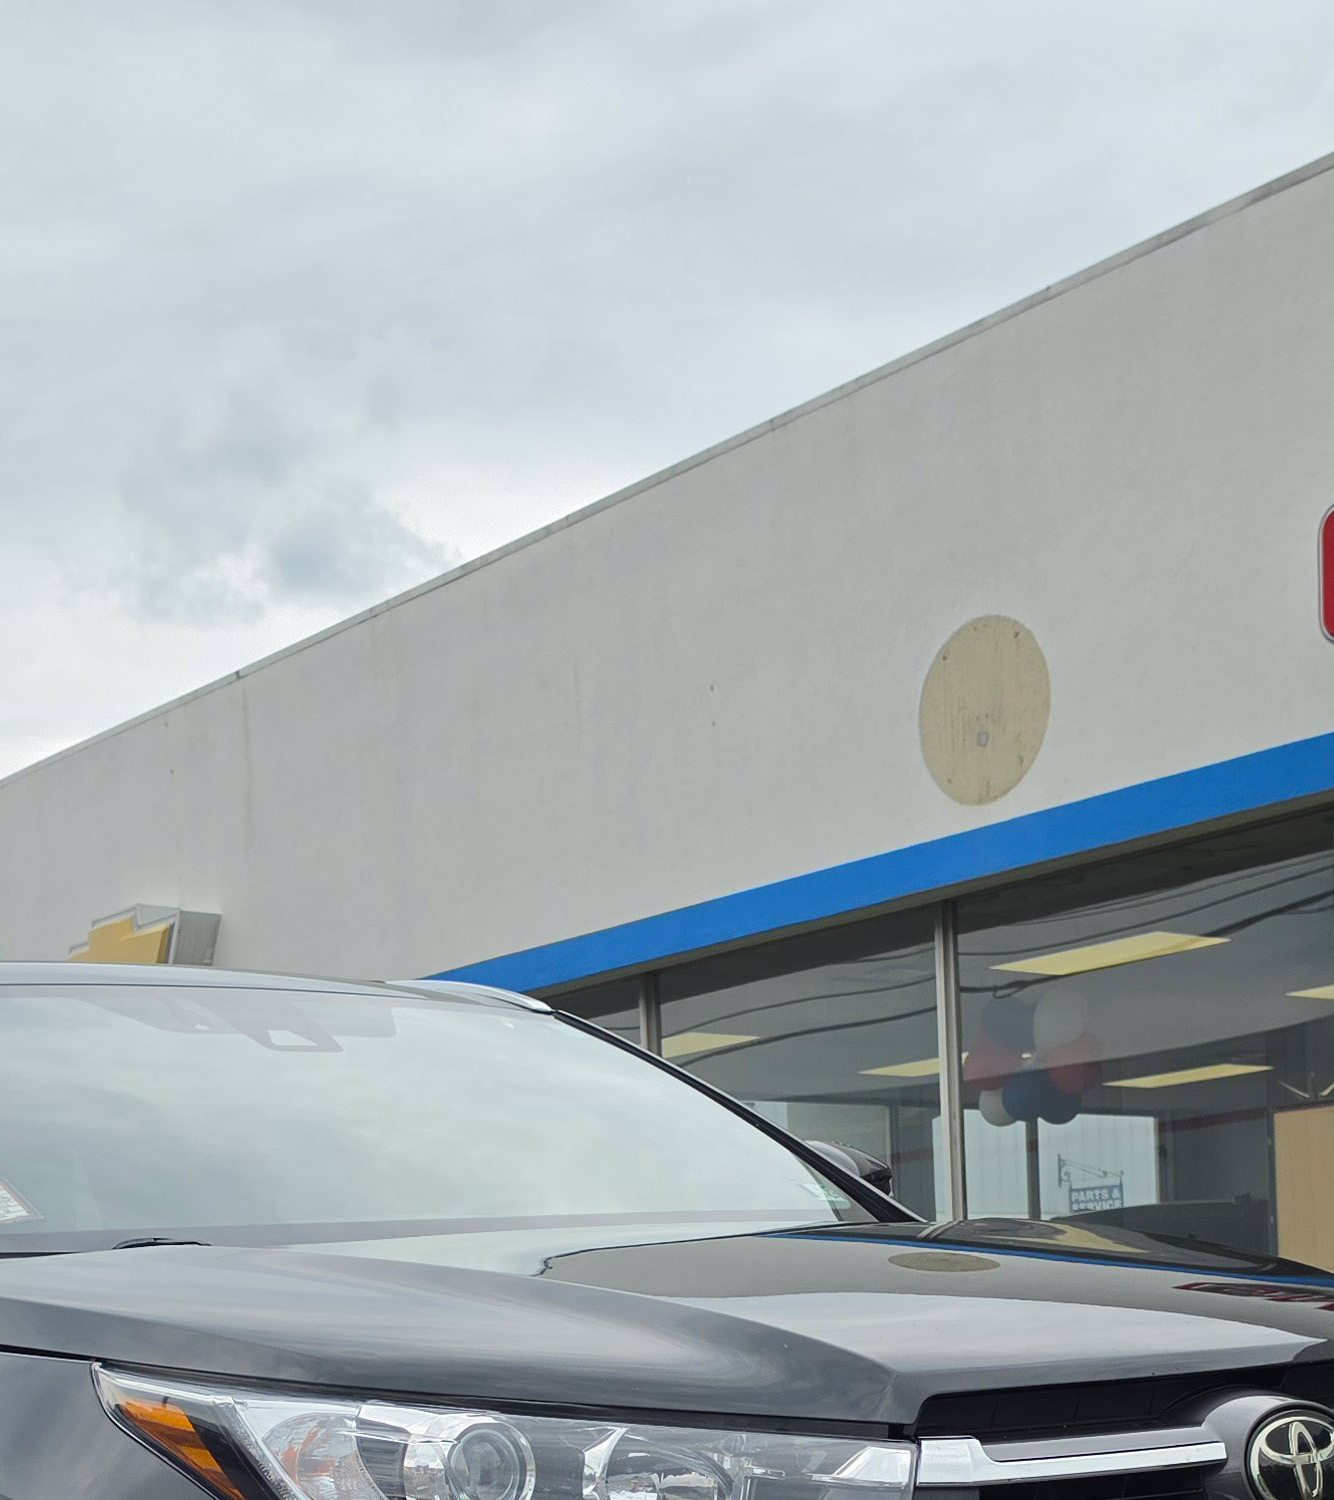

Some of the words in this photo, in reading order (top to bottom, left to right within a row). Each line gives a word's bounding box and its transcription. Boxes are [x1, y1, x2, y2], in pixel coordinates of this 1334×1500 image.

[1071, 1188, 1108, 1202] PARTS
[1112, 1188, 1121, 1199] &
[1072, 1200, 1122, 1211] SERVICE
